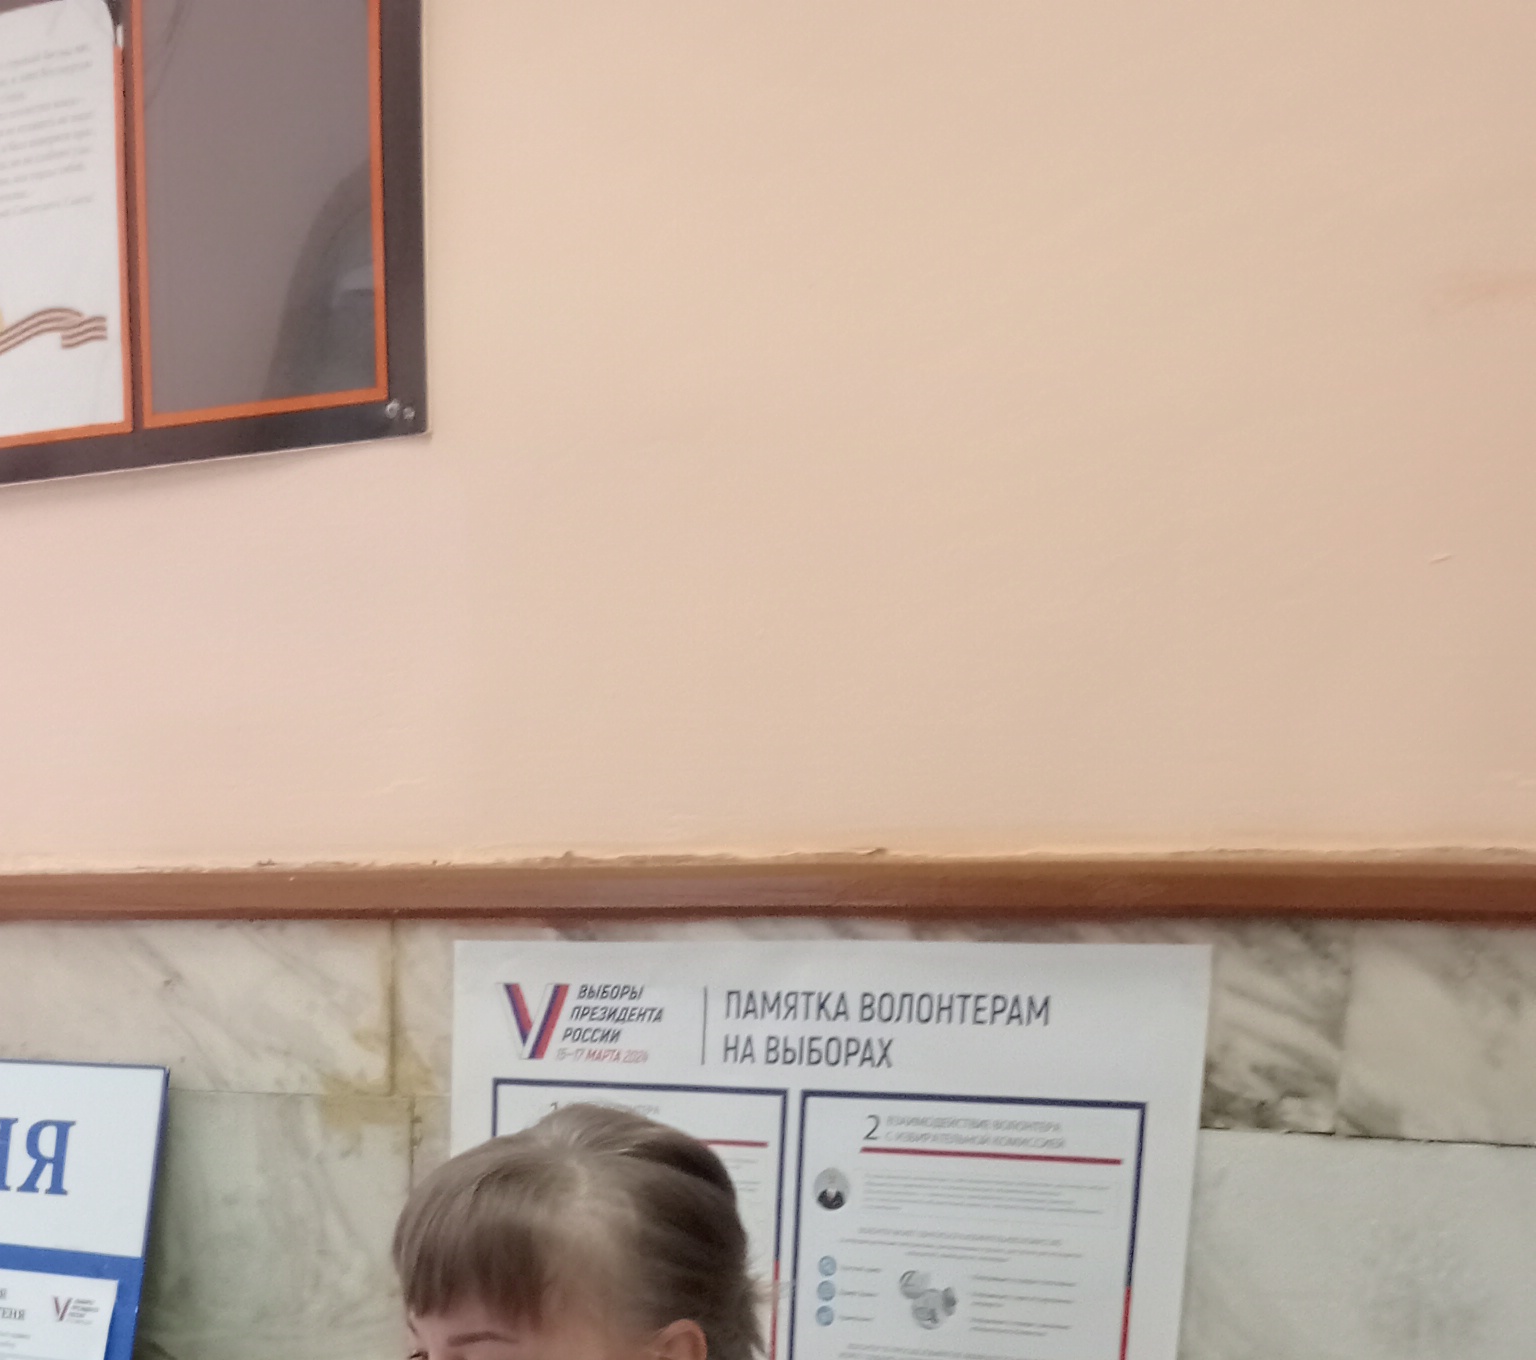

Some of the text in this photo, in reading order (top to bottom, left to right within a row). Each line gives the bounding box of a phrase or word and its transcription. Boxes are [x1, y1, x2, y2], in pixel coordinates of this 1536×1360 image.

[577, 984, 644, 1000] ВЫБОРЫ
[570, 1006, 664, 1023] ПРЕЗИДЕНТА
[724, 990, 1051, 1027] ПАМЯТКА ВОЛОНТЕРАМ
[562, 1027, 620, 1043] РОССИИ
[584, 1049, 621, 1062] МАРТА
[722, 1034, 894, 1068] НА ВЫБОРАХ
[862, 1114, 881, 1141] 2
